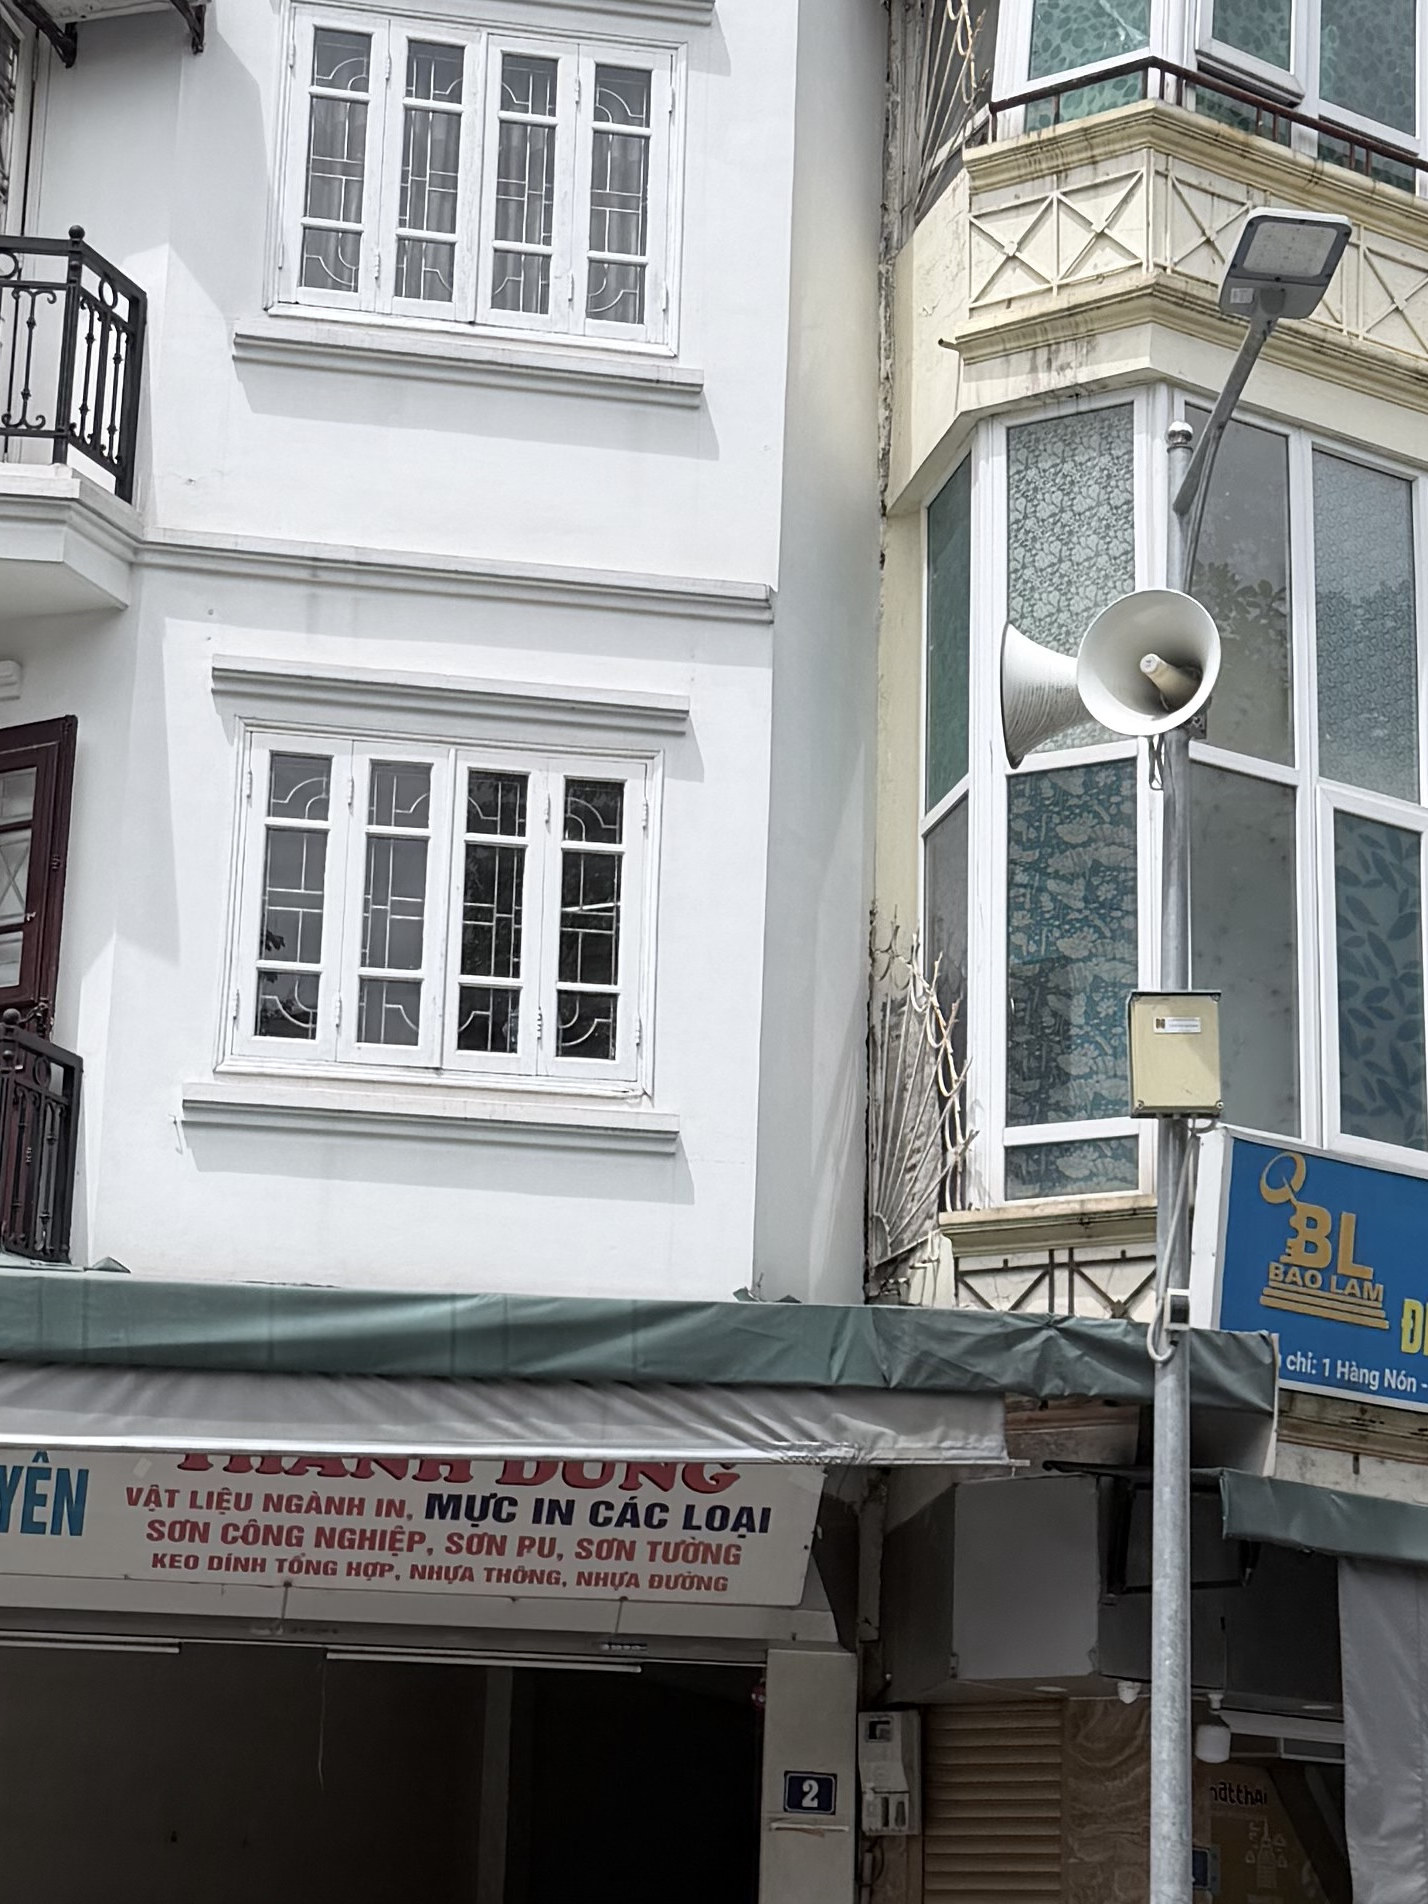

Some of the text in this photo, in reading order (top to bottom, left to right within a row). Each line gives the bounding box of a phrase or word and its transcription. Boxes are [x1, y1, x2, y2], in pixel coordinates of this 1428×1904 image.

[1269, 1262, 1385, 1303] BAO LAM
[1286, 1351, 1317, 1375] chỉ:
[1323, 1357, 1331, 1376] 1
[1337, 1359, 1379, 1390] Hàng
[1384, 1368, 1417, 1393] Nón
[126, 1484, 772, 1538] VẬT LIỆU NGÀNH IN, MỰC IN CÁC LOẠI
[146, 1518, 742, 1565] SƠN CÔNG NGHIỆP, SƠN PU, SƠN TƯỜNG
[151, 1552, 729, 1592] KEO DÍNH TỔNG HỢP, NHỰA THÔNG, NHỰA ĐƯỜNG
[801, 1778, 819, 1808] 2
